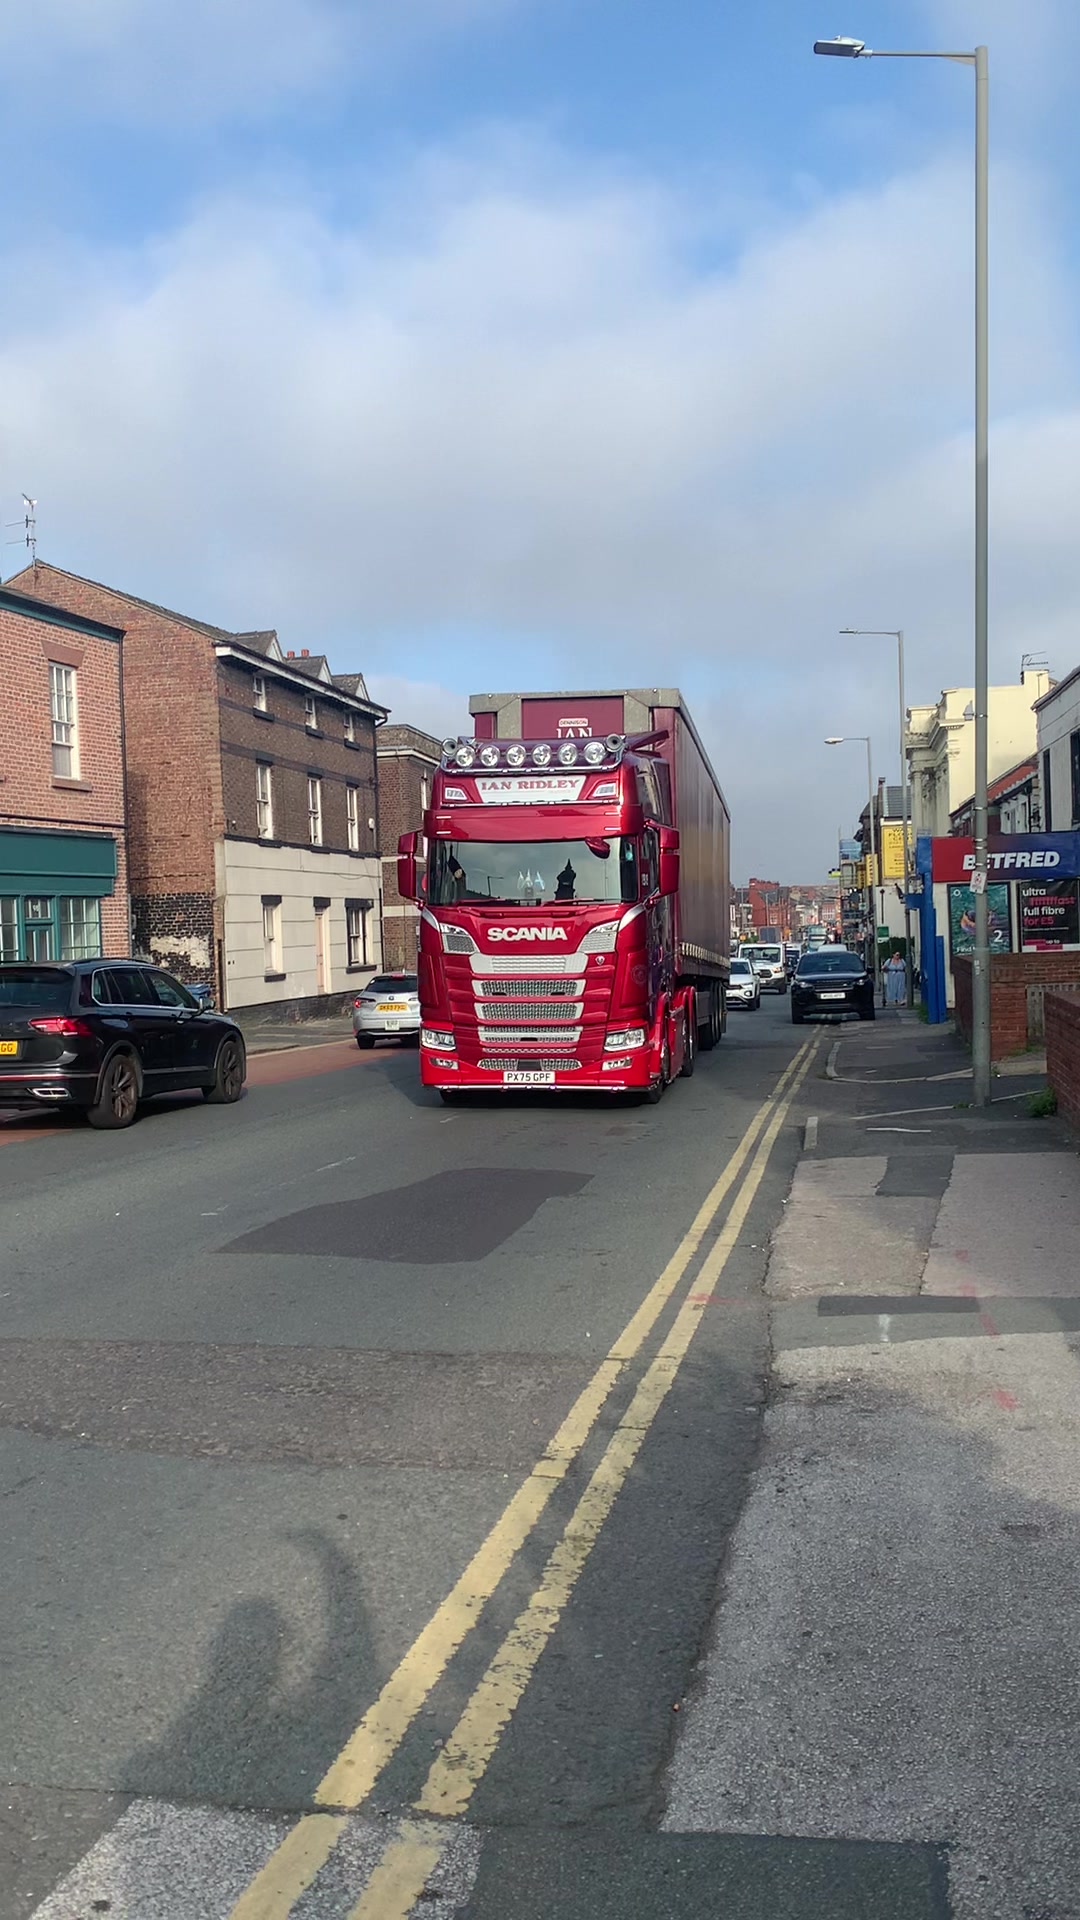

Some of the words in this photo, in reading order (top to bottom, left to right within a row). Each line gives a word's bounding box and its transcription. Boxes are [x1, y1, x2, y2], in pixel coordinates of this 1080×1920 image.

[481, 781, 512, 790] IAN
[516, 780, 580, 789] RIDLEY
[962, 851, 1060, 870] BTFRED
[1022, 888, 1046, 896] ultra
[1023, 907, 1039, 916] full
[1041, 906, 1065, 915] fibre
[1024, 917, 1039, 925] for
[1041, 917, 1054, 925] £5
[487, 927, 568, 941] SCANIA
[993, 930, 1003, 942] 2
[507, 1073, 531, 1081] PX75
[533, 1073, 551, 1081] GPF
